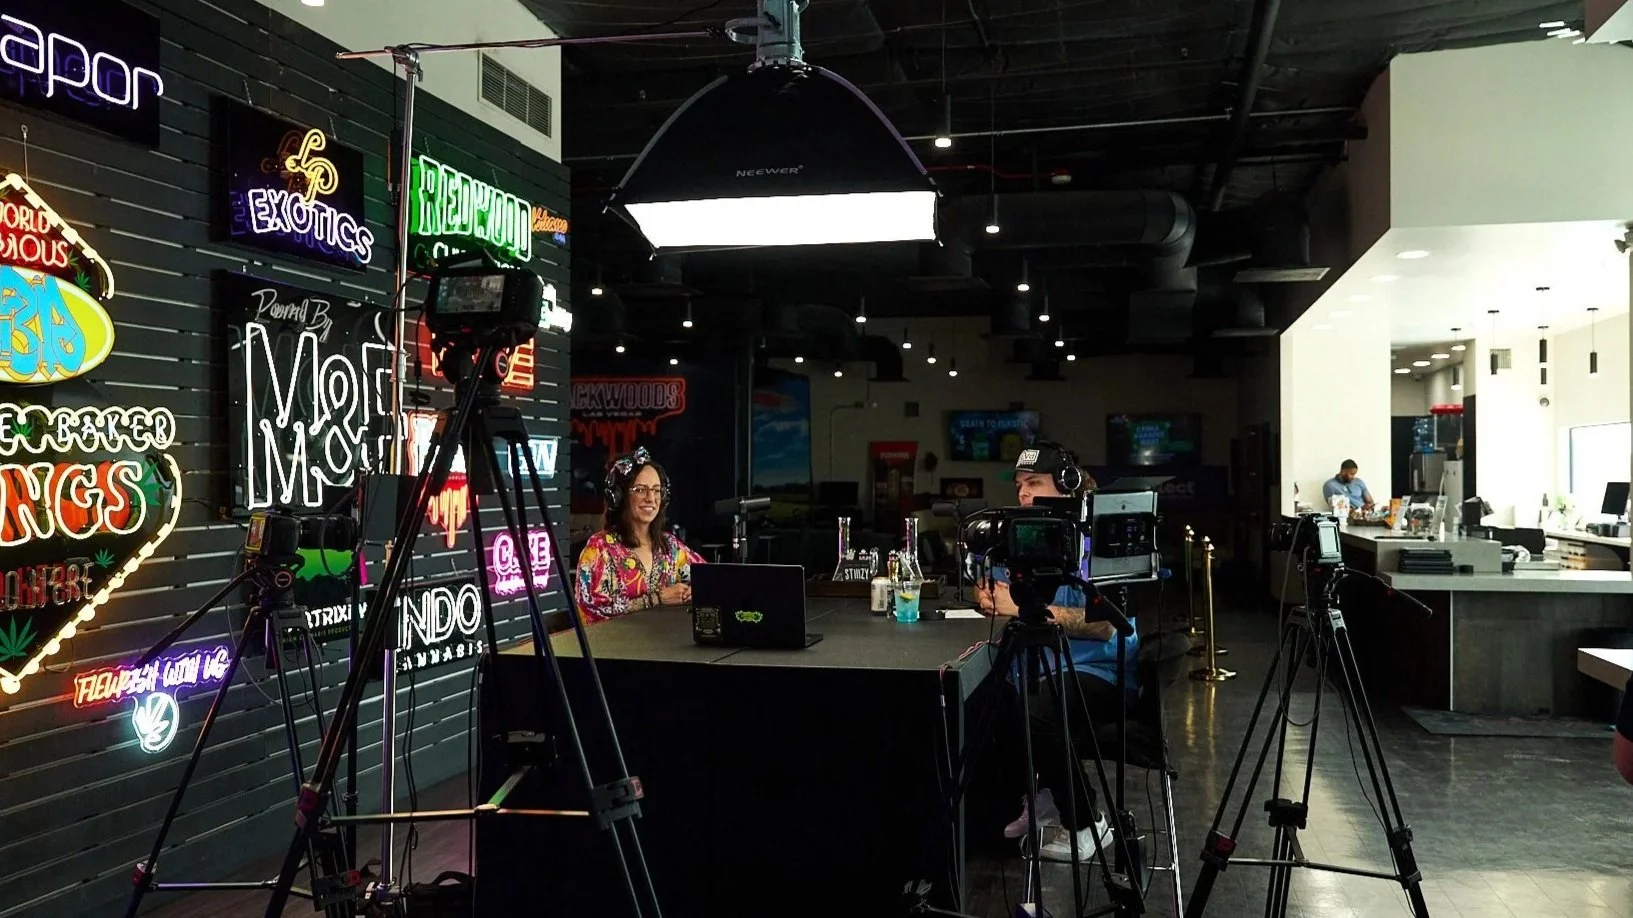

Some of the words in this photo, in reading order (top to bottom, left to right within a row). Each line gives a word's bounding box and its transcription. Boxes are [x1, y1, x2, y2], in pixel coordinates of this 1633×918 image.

[736, 167, 799, 178] NEEWER
[413, 155, 532, 262] REDWOOD
[248, 188, 374, 264] EXOTICS
[570, 382, 680, 410] CKWOODS
[57, 411, 168, 445] BAKER
[402, 639, 483, 671] ANNABIS
